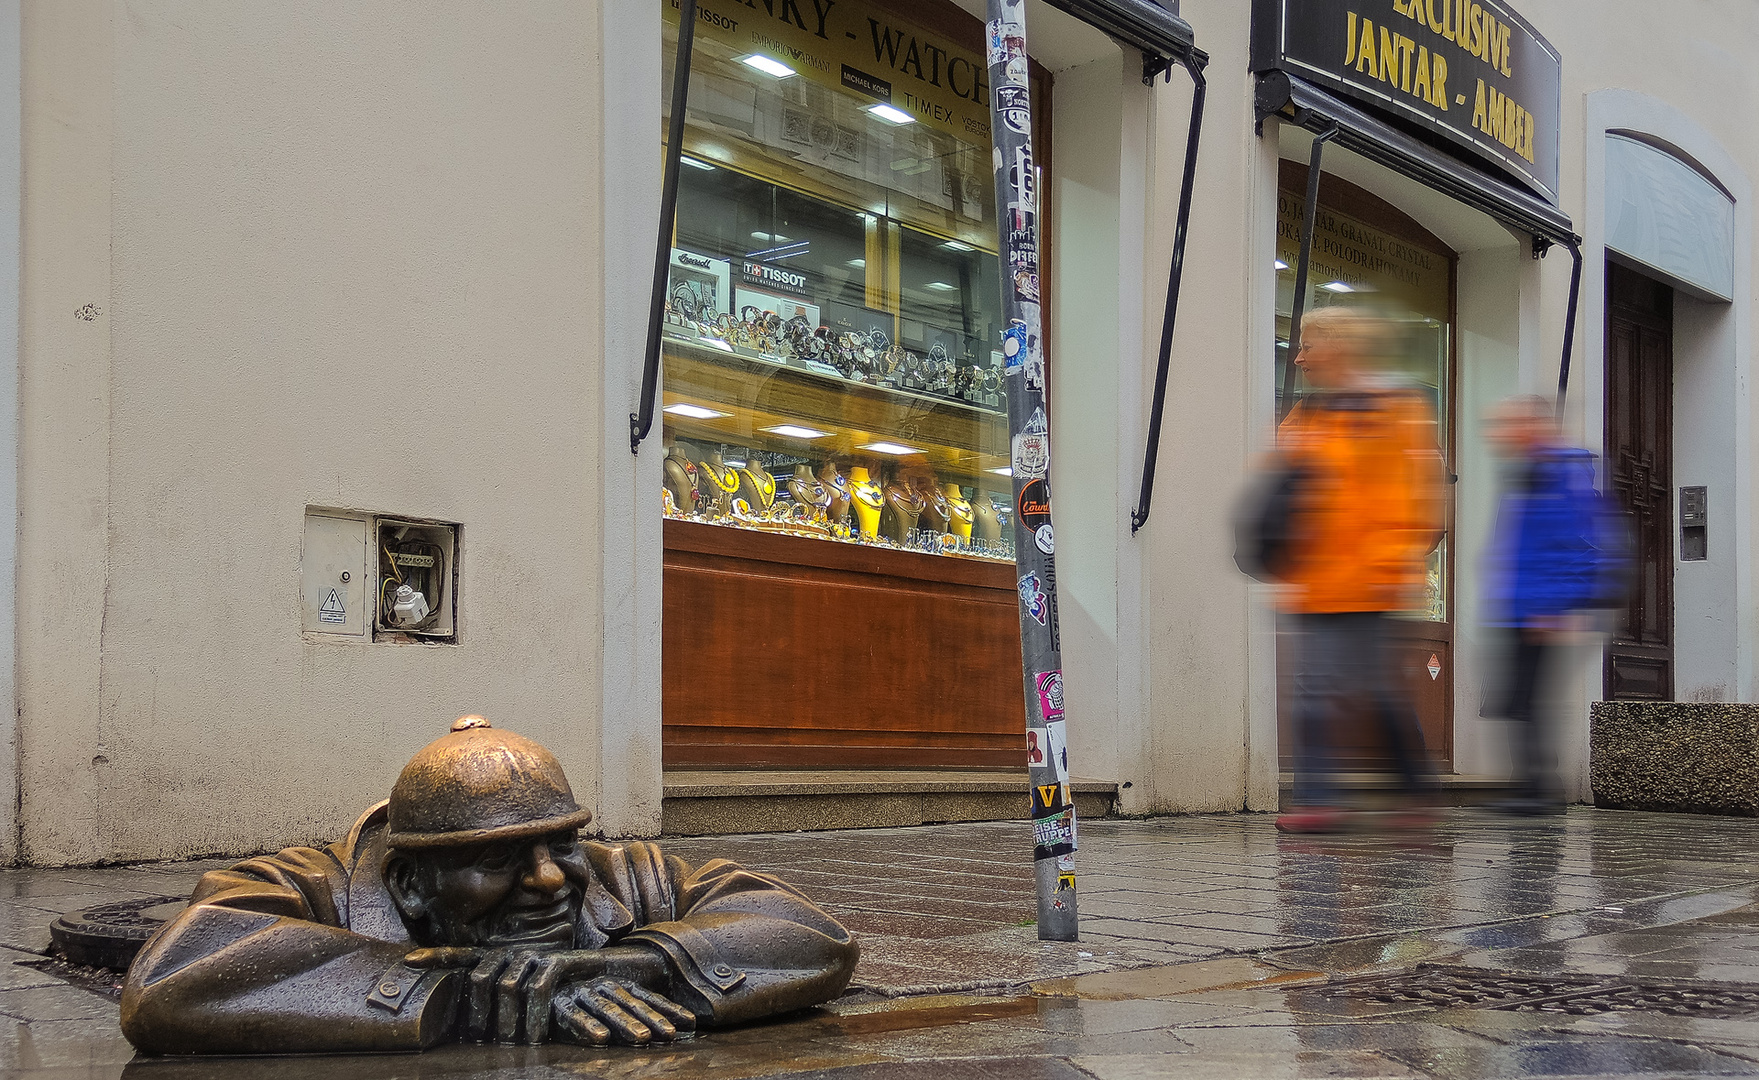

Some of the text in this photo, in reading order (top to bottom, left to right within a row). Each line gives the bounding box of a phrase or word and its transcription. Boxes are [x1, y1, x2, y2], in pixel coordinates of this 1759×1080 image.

[751, 31, 830, 73] EMPORIO ARMANI
[843, 71, 889, 96] MICHAEL KORS
[1344, 11, 1449, 111] JANTAR
[1472, 78, 1534, 164] AMBER
[904, 92, 953, 126] TIMEX
[761, 266, 806, 288] TISSOT
